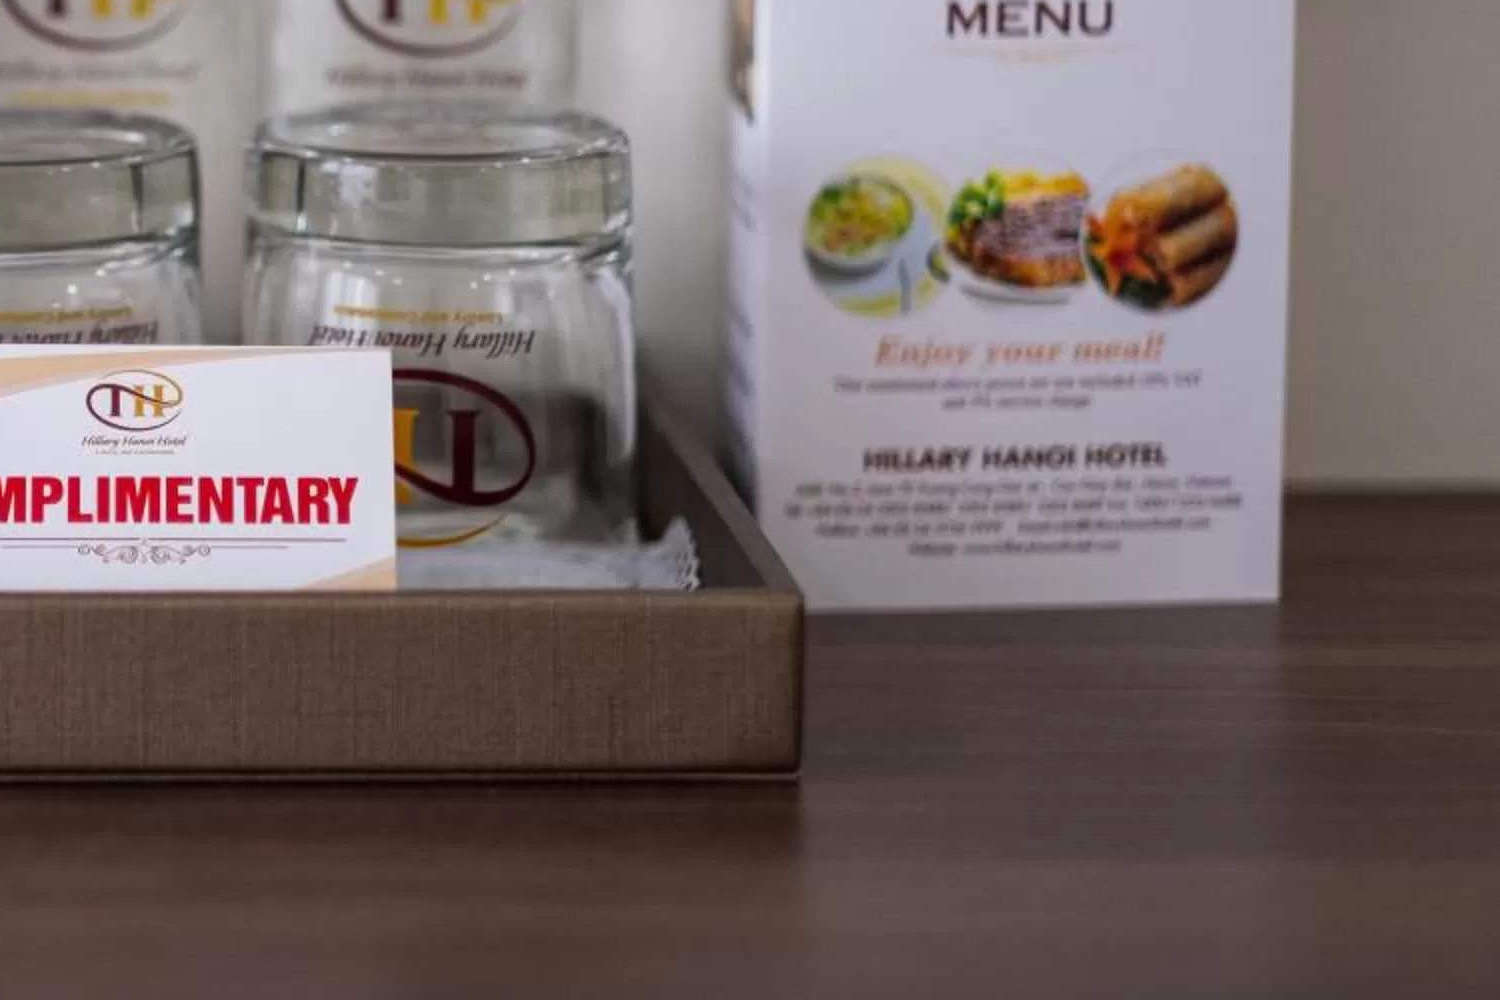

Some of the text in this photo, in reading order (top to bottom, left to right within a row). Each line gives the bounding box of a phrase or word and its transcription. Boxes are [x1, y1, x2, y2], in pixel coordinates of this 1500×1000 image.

[946, 0, 1114, 38] MENU
[453, 326, 535, 359] Hillary
[875, 334, 972, 370] Enjoy
[984, 341, 1062, 370] your
[862, 442, 1167, 473] HILLARY HANOI HOTEL
